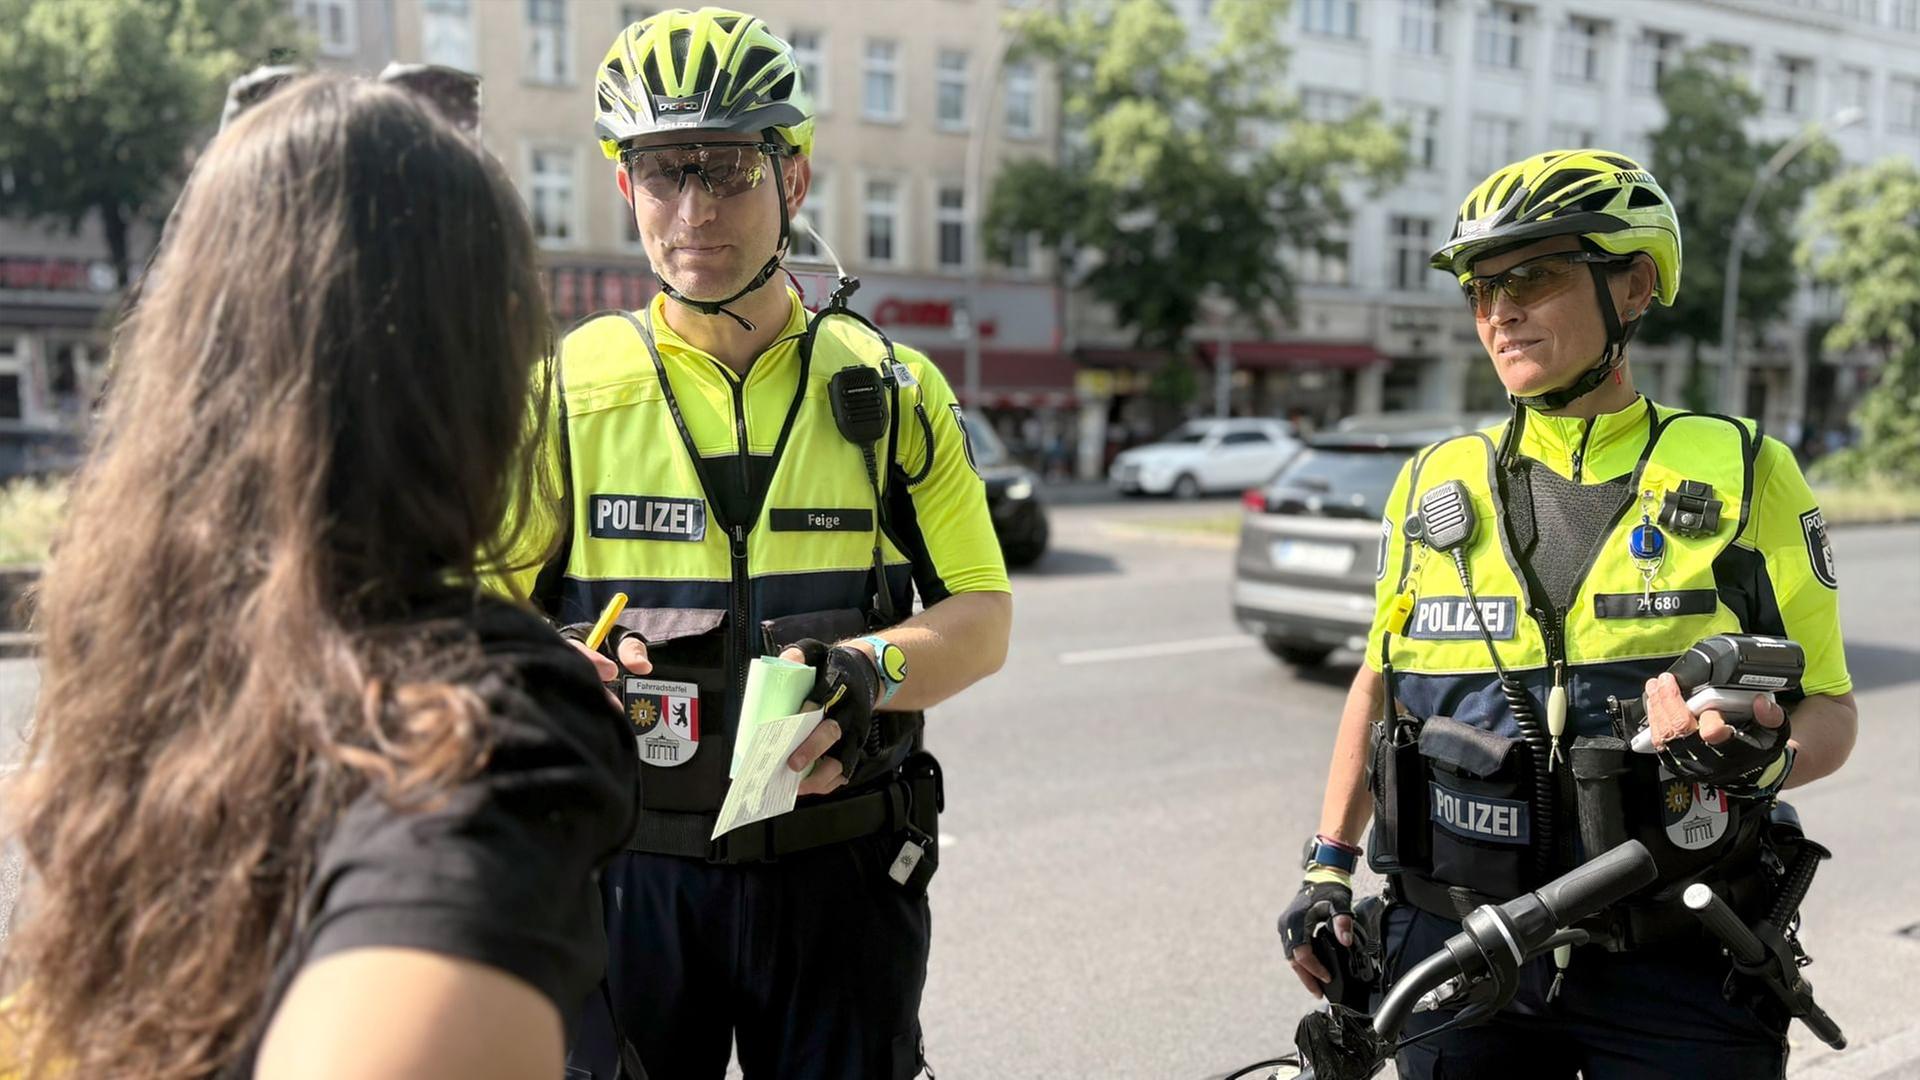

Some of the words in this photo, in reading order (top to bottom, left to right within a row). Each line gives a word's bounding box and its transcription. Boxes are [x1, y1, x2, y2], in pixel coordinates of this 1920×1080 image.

[1614, 171, 1655, 185] POLIZE
[597, 499, 694, 534] POLIZEI
[807, 513, 841, 529] Feige
[1416, 601, 1506, 632] POLIZEI
[636, 681, 688, 694] Fahrradstaffel
[1435, 788, 1518, 837] POLIZEI
